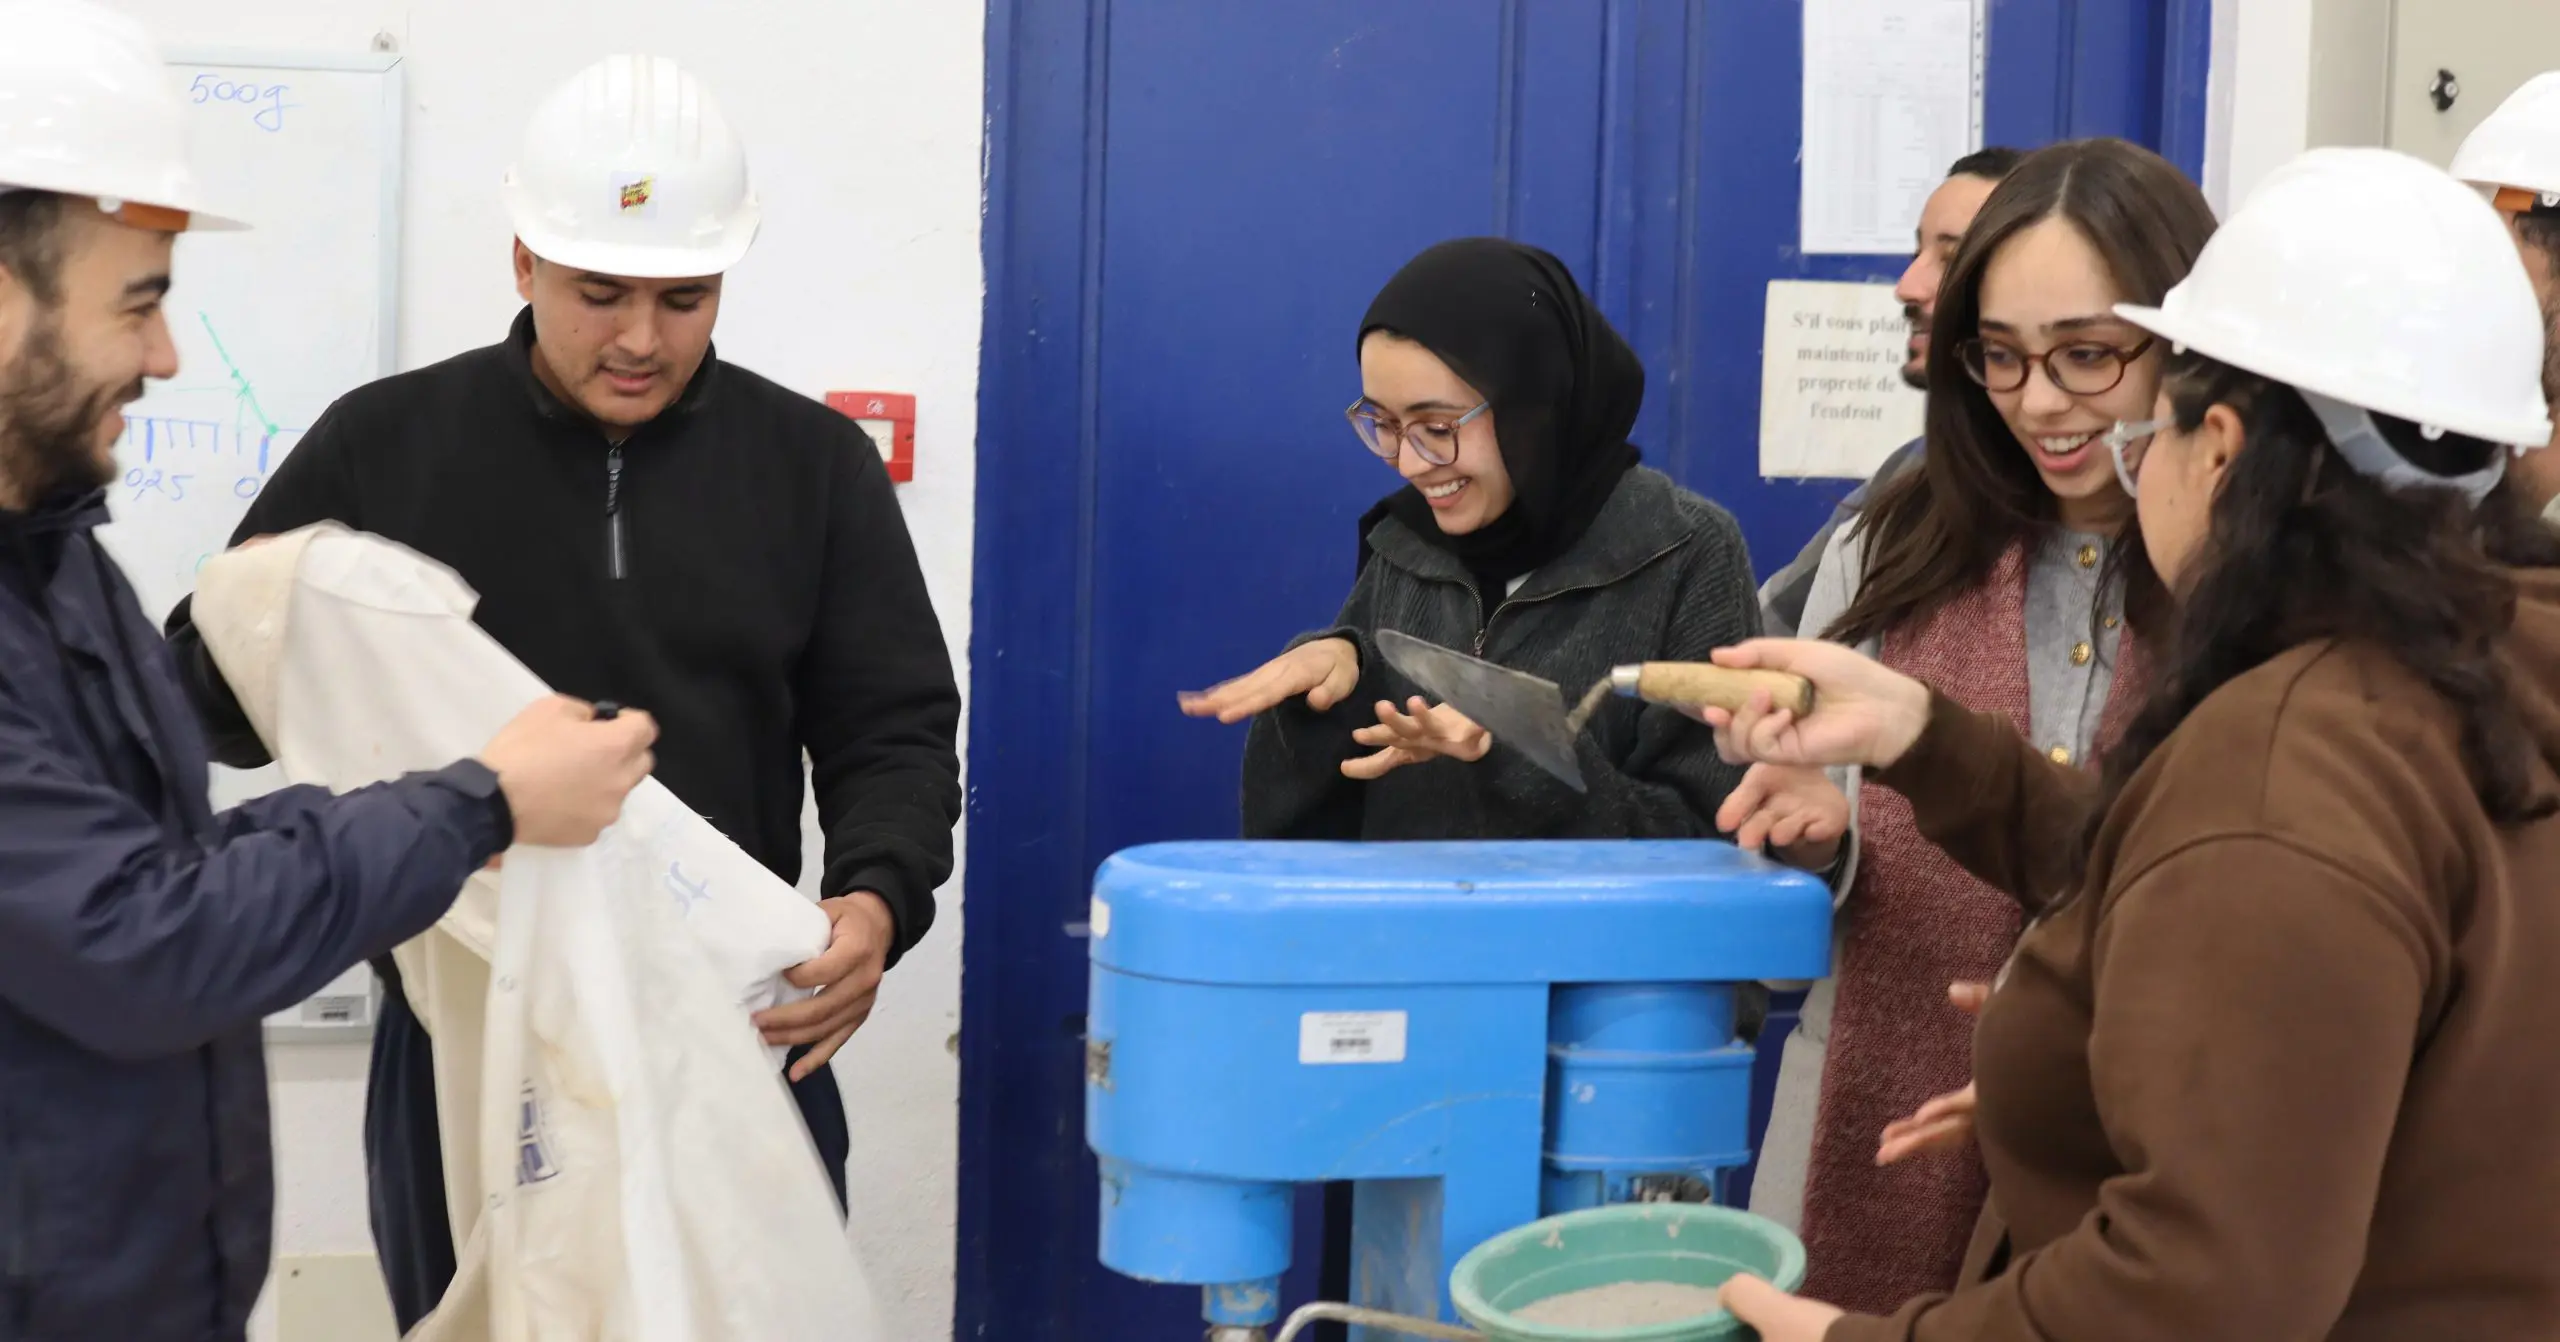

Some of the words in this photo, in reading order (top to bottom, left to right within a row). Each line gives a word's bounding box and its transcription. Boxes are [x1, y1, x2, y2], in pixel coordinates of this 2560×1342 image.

[190, 73, 303, 132] 500g
[1793, 311, 1820, 329] S'il
[1826, 317, 1863, 330] vous
[1797, 345, 1880, 363] maintenir
[1886, 347, 1899, 364] la
[1798, 375, 1874, 394] propreté
[1876, 375, 1897, 393] de
[125, 468, 195, 502] 0,25
